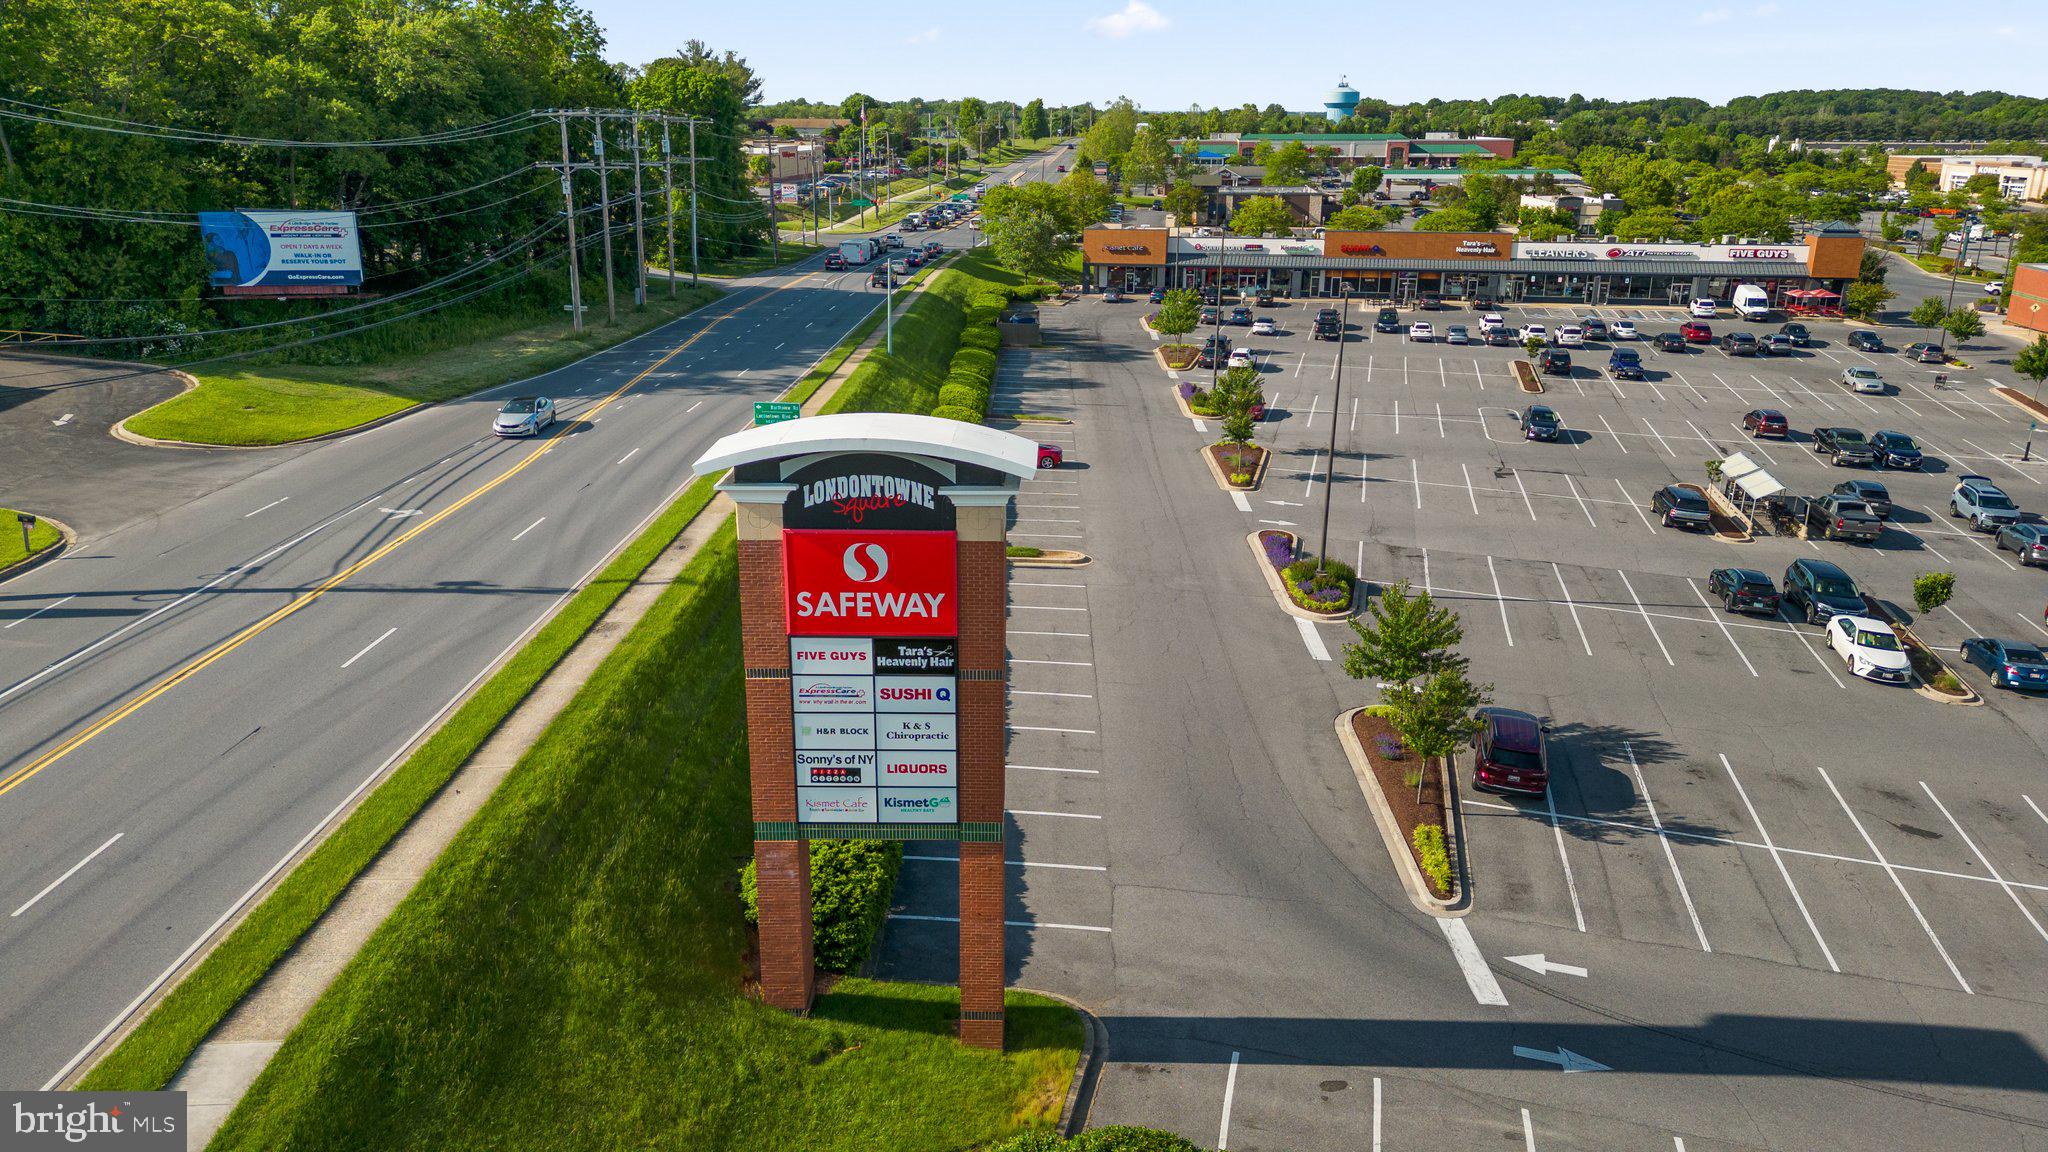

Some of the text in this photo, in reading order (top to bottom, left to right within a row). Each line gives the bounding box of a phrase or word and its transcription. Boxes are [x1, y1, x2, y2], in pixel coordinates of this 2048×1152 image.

[270, 224, 340, 232] ExpressCare
[1524, 249, 1588, 258] CLEANERS
[1729, 249, 1788, 258] FIVE GUYS
[803, 474, 934, 509] LONDONTOWNE
[833, 492, 907, 523] Square
[796, 592, 945, 618] SAFEWAY
[796, 651, 867, 660] FIVE GUYS
[897, 646, 933, 656] Tara's
[876, 656, 955, 669] Heavenly Hair
[879, 687, 951, 701] SUSHI Q
[902, 721, 931, 730] K & S
[886, 731, 950, 741] Chiropractic
[797, 753, 874, 766] Sonny's of NY
[811, 768, 847, 776] PIZZA
[886, 763, 948, 774] LIQUORS
[805, 796, 868, 808] Kismet Cafe
